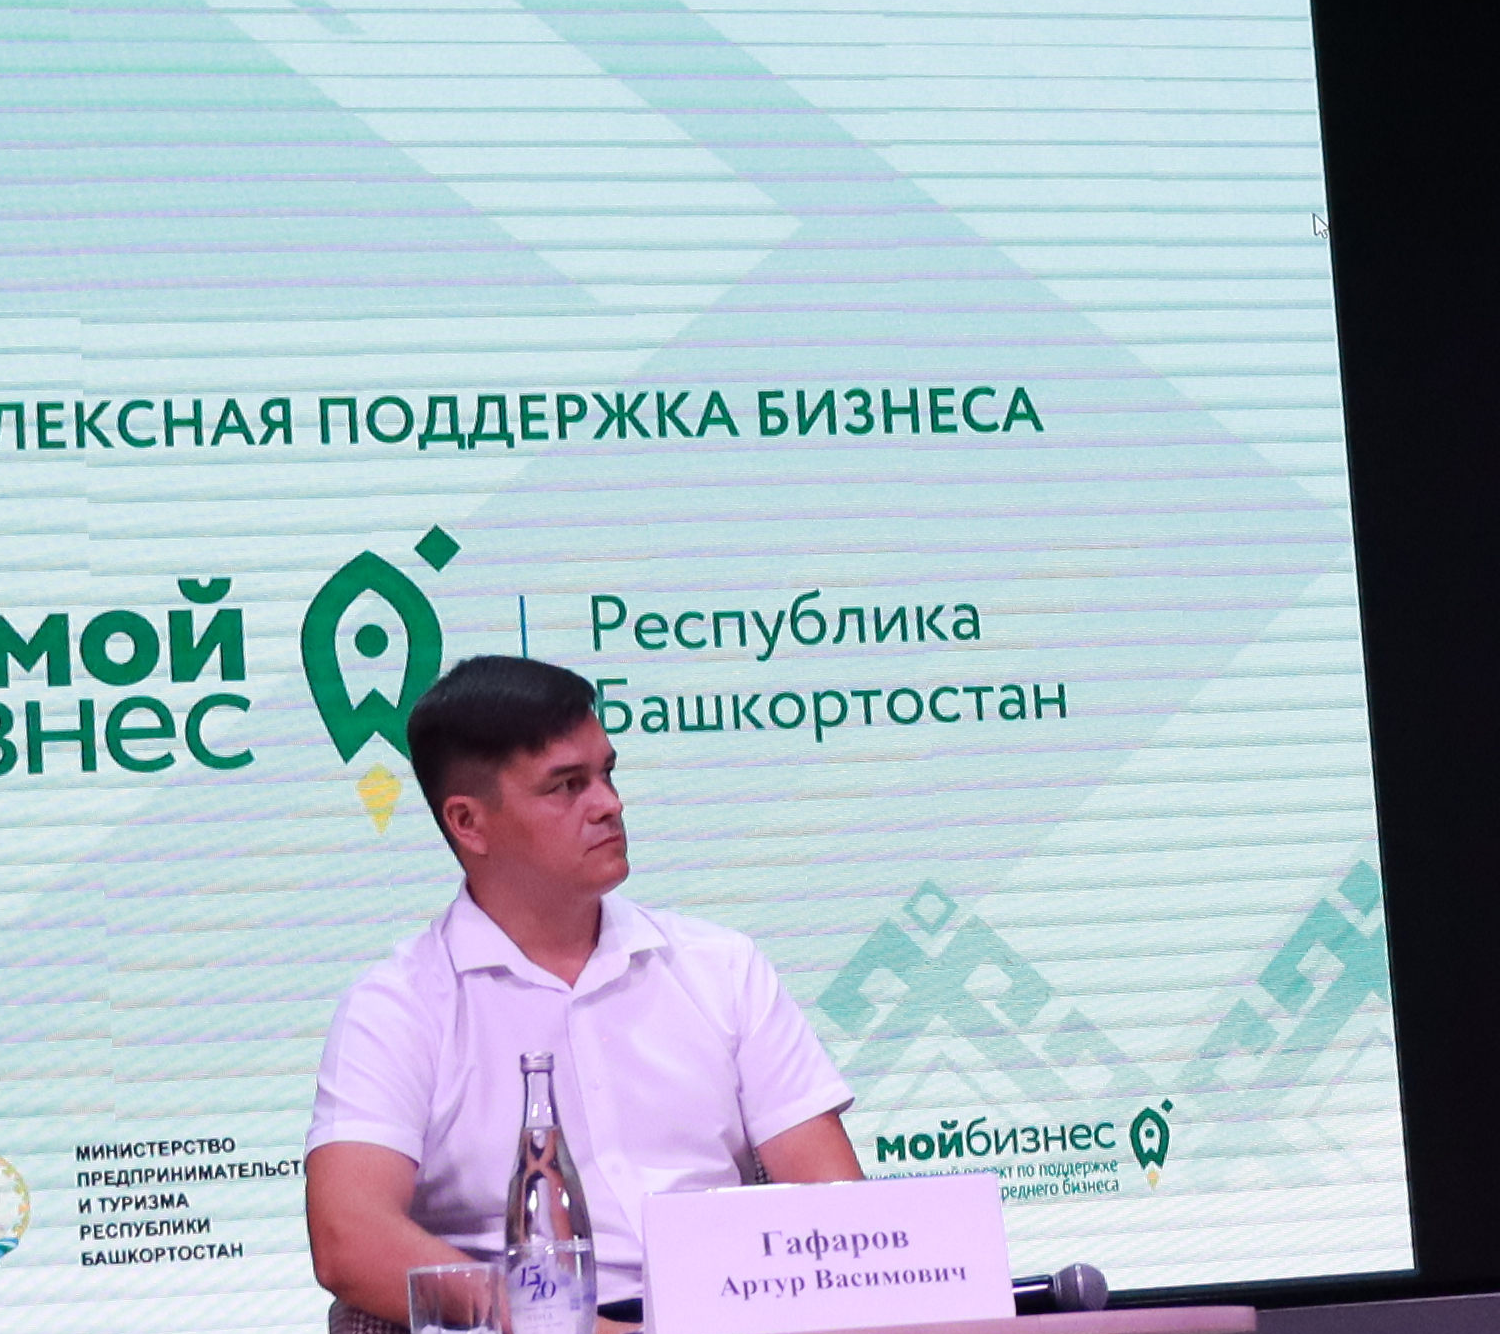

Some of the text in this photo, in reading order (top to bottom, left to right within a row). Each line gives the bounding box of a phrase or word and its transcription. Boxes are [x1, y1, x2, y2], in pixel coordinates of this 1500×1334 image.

[317, 391, 741, 452] ПОДДЕРЖКА
[756, 385, 1044, 439] БИЗНЕСА
[591, 589, 982, 662] Республика
[596, 678, 1069, 743] Башкортостан
[75, 1137, 236, 1161] МИНИСТЕРСТВО
[876, 1117, 1116, 1163] мойбизнес
[77, 1160, 306, 1187] ПРЕДПРИНИМАТЕЛЬСТ
[1017, 1164, 1034, 1178] по
[1038, 1160, 1118, 1179] поддержке
[78, 1193, 190, 1214] И ТУРИЗМА
[1001, 1178, 1119, 1203] реднего бизнеса
[80, 1218, 212, 1241] РЕСПУБЛИКИ
[81, 1243, 244, 1267] БАШКОРТОСТАН
[761, 1228, 910, 1261] Гафаров
[720, 1266, 968, 1301] Артур Васимович
